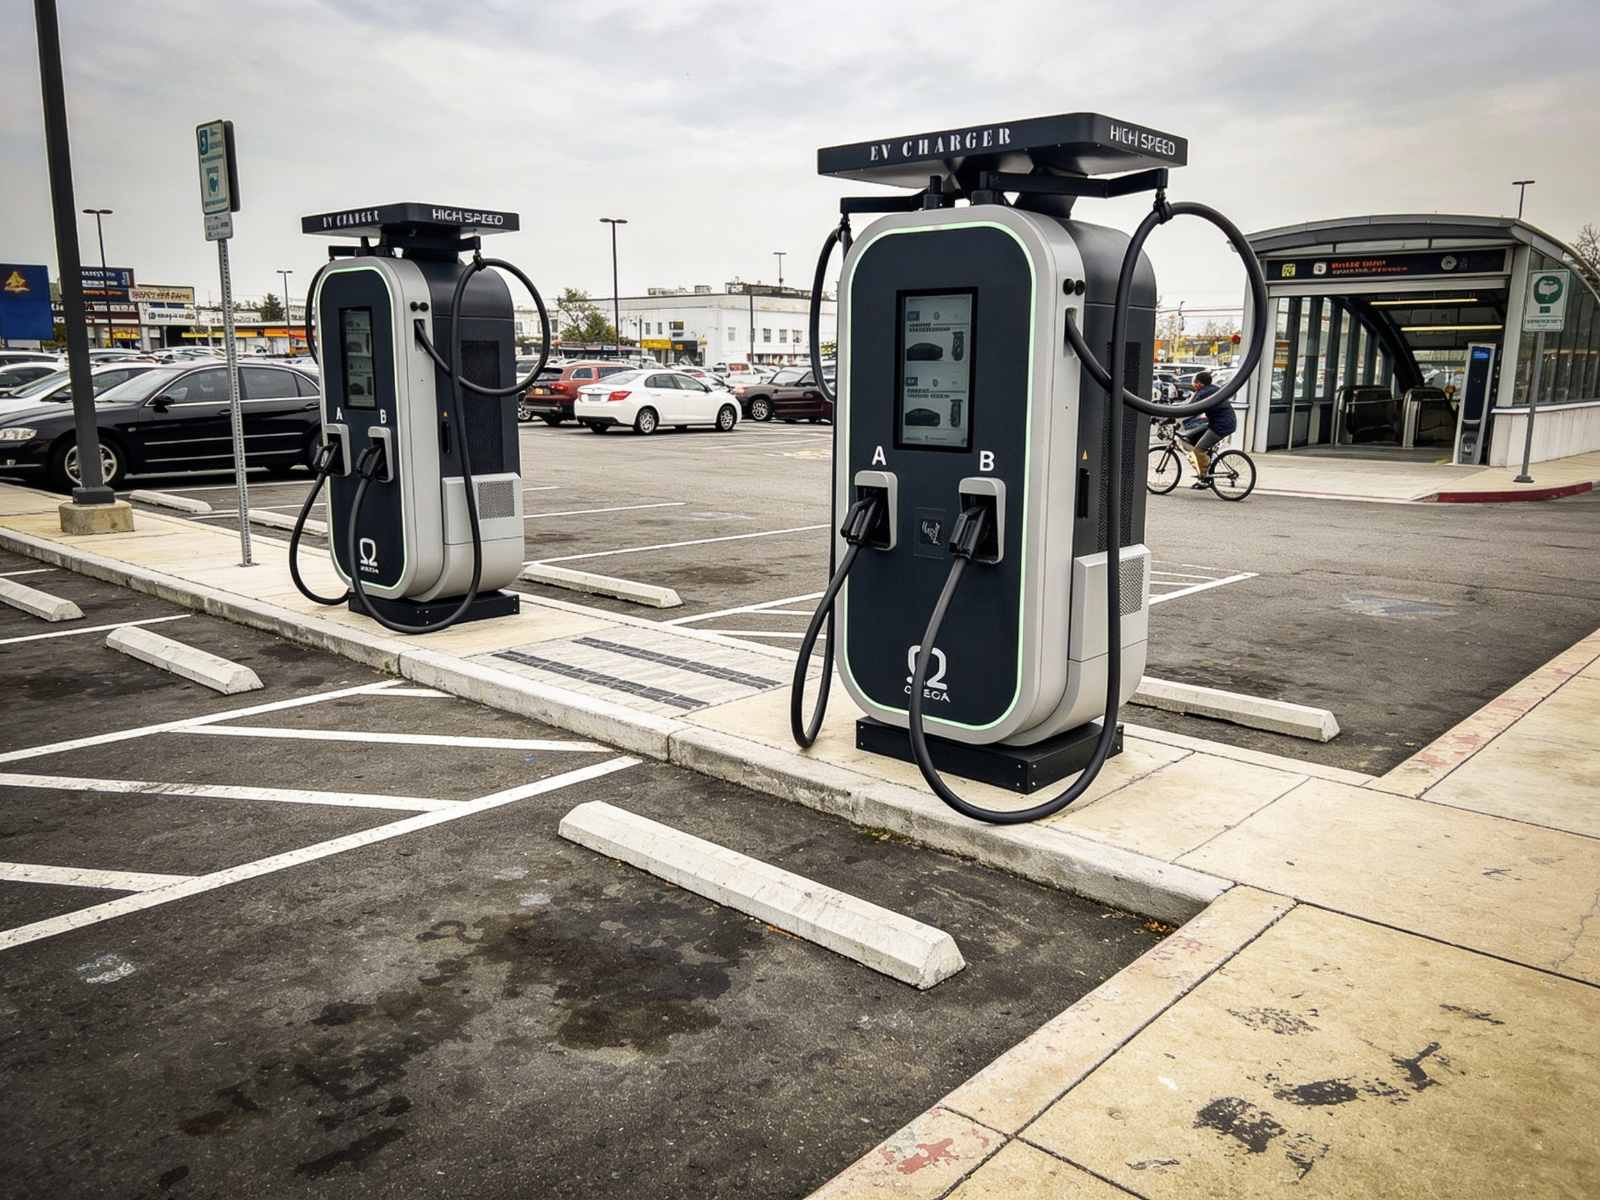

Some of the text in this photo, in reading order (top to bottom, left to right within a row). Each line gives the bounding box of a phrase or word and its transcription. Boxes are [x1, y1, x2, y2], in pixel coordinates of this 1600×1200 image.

[870, 127, 1011, 161] EV CHARGER
[1141, 133, 1176, 156] SPEED
[432, 208, 504, 226] HIGH SPEED
[335, 406, 344, 421] A
[380, 408, 387, 424] B
[871, 445, 887, 466] A
[979, 450, 995, 472] B
[904, 685, 951, 703] OEGA
